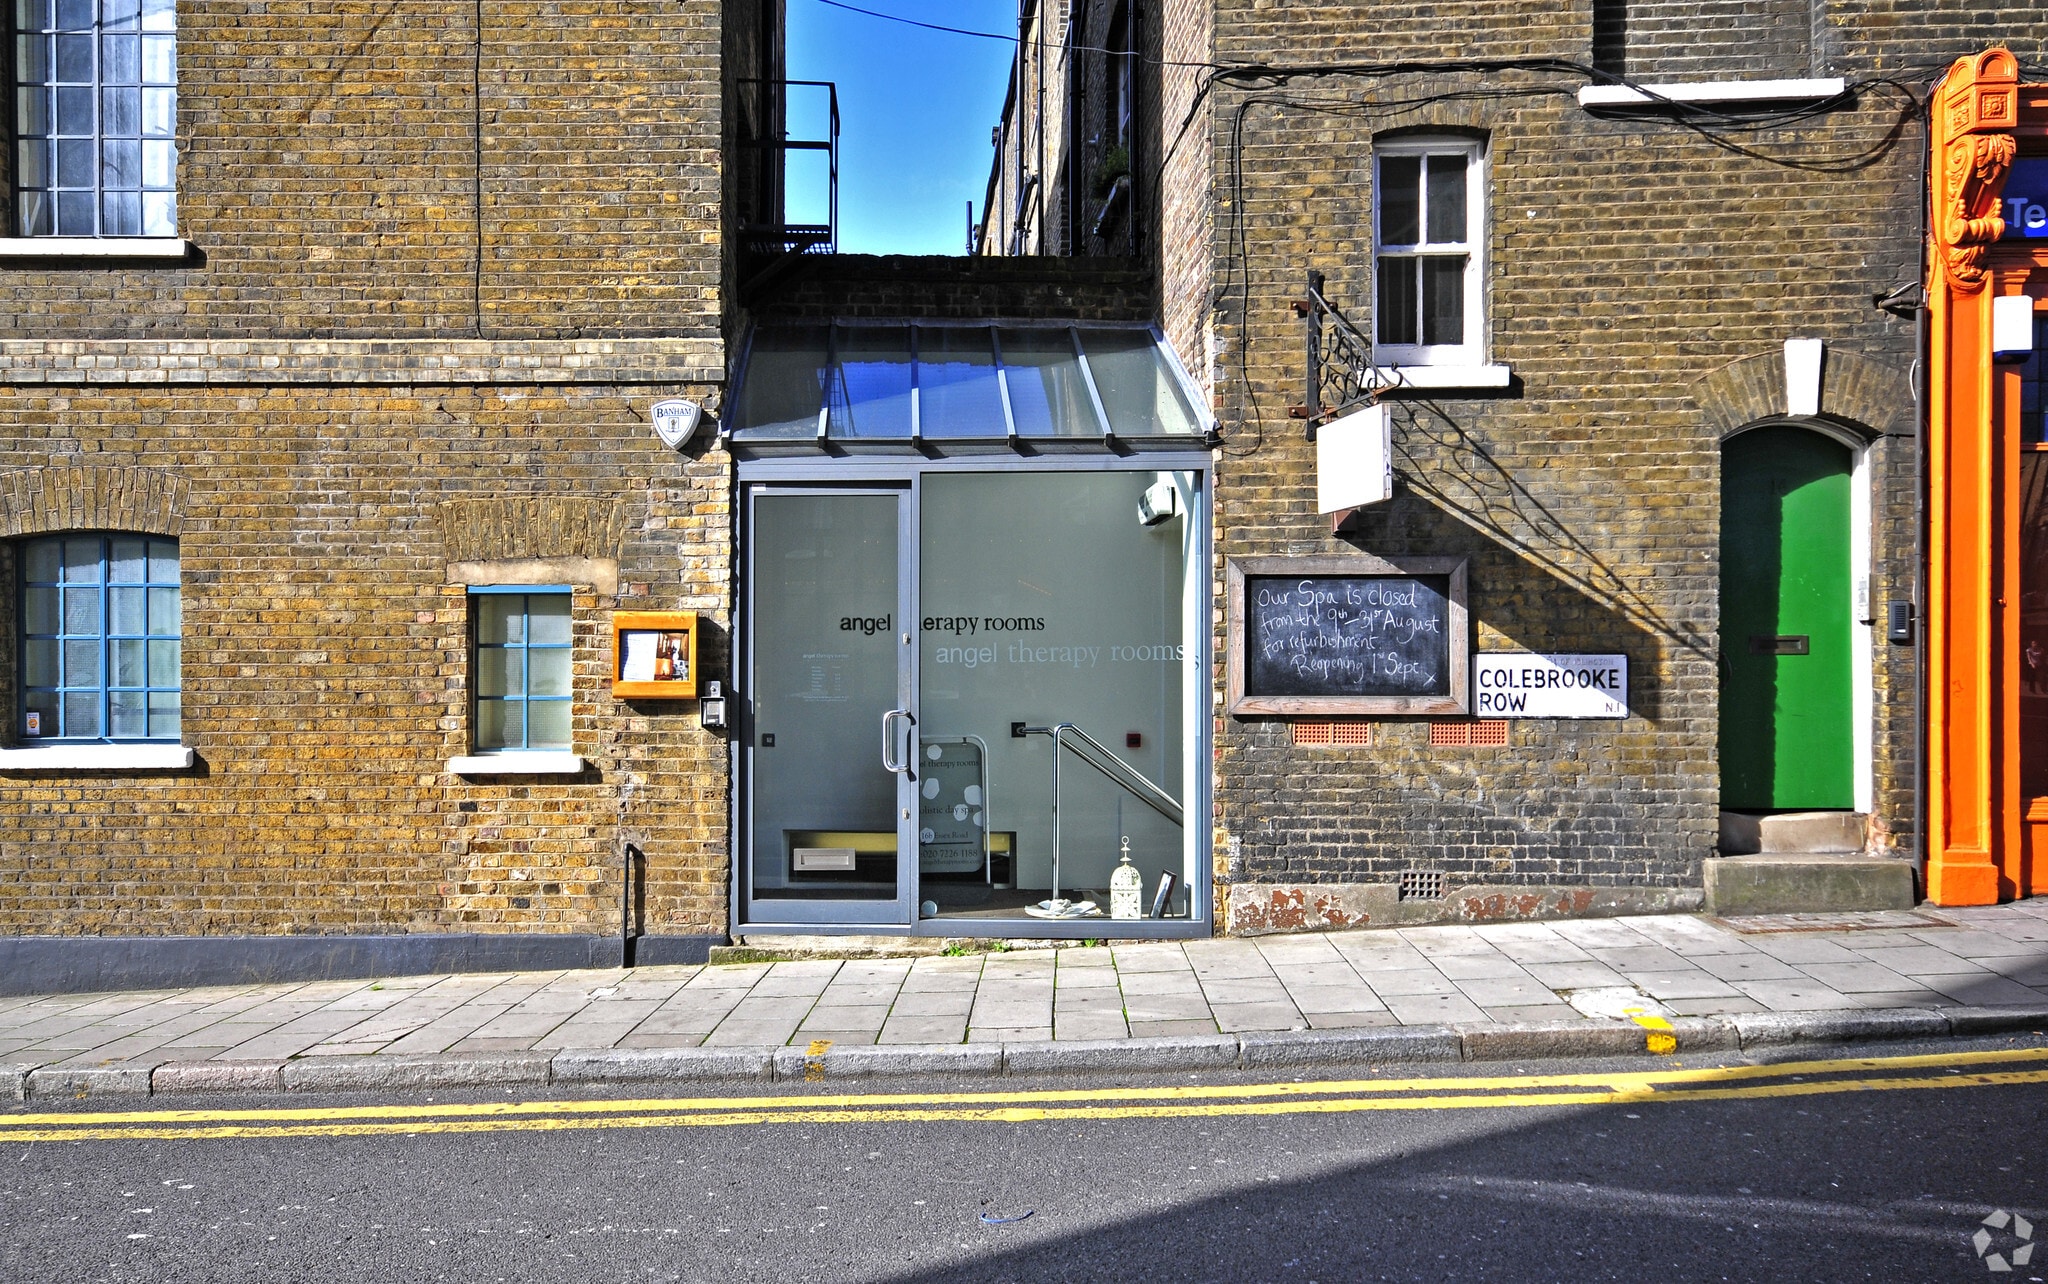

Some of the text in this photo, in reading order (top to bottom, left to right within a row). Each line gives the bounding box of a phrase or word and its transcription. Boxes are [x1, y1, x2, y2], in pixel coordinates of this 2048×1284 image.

[656, 407, 692, 418] BANHAM
[1257, 580, 1417, 615] Our Spa is closed
[840, 613, 1045, 636] angel erapy rooms
[1261, 611, 1293, 637] from
[1295, 609, 1321, 627] the
[1383, 609, 1440, 645] August
[935, 642, 998, 669] angel
[1008, 639, 1101, 669] therapy
[1263, 637, 1285, 660] for
[1290, 654, 1364, 684] Reopening
[1480, 668, 1620, 689] COLEBROOKE
[1480, 692, 1527, 712] ROW
[928, 759, 956, 769] therapy
[920, 804, 974, 815] olistic day spa
[940, 849, 959, 858] 7226
[961, 849, 978, 858] 1188
